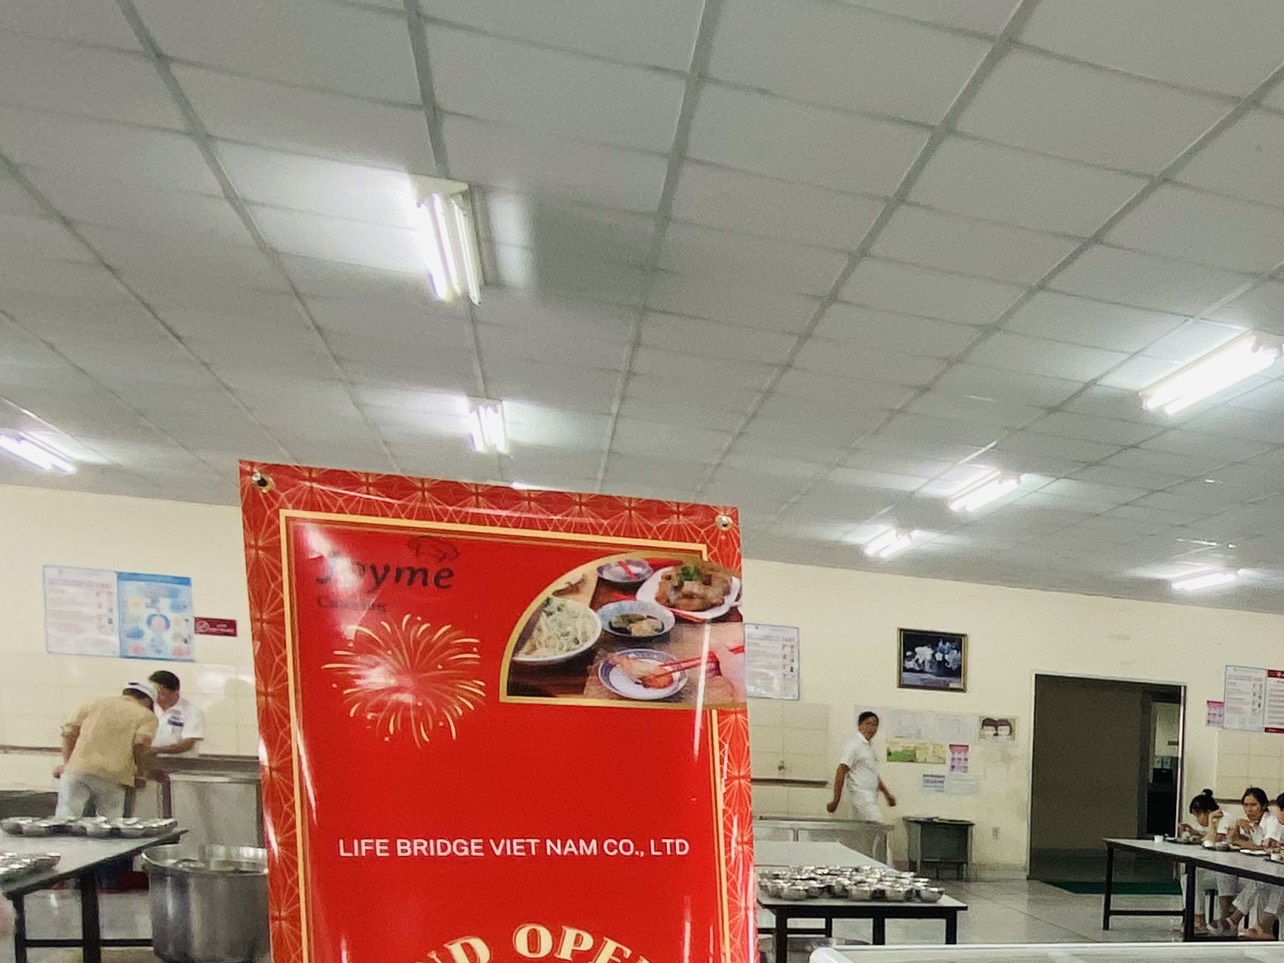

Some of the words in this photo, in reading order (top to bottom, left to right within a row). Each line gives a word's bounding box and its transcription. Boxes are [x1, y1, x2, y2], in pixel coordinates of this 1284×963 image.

[338, 838, 390, 857] LIFE
[396, 838, 485, 857] BRIDGE
[489, 838, 540, 857] VIET
[546, 838, 598, 856] NAM
[603, 838, 645, 858] CO.,
[650, 838, 690, 856] LTD
